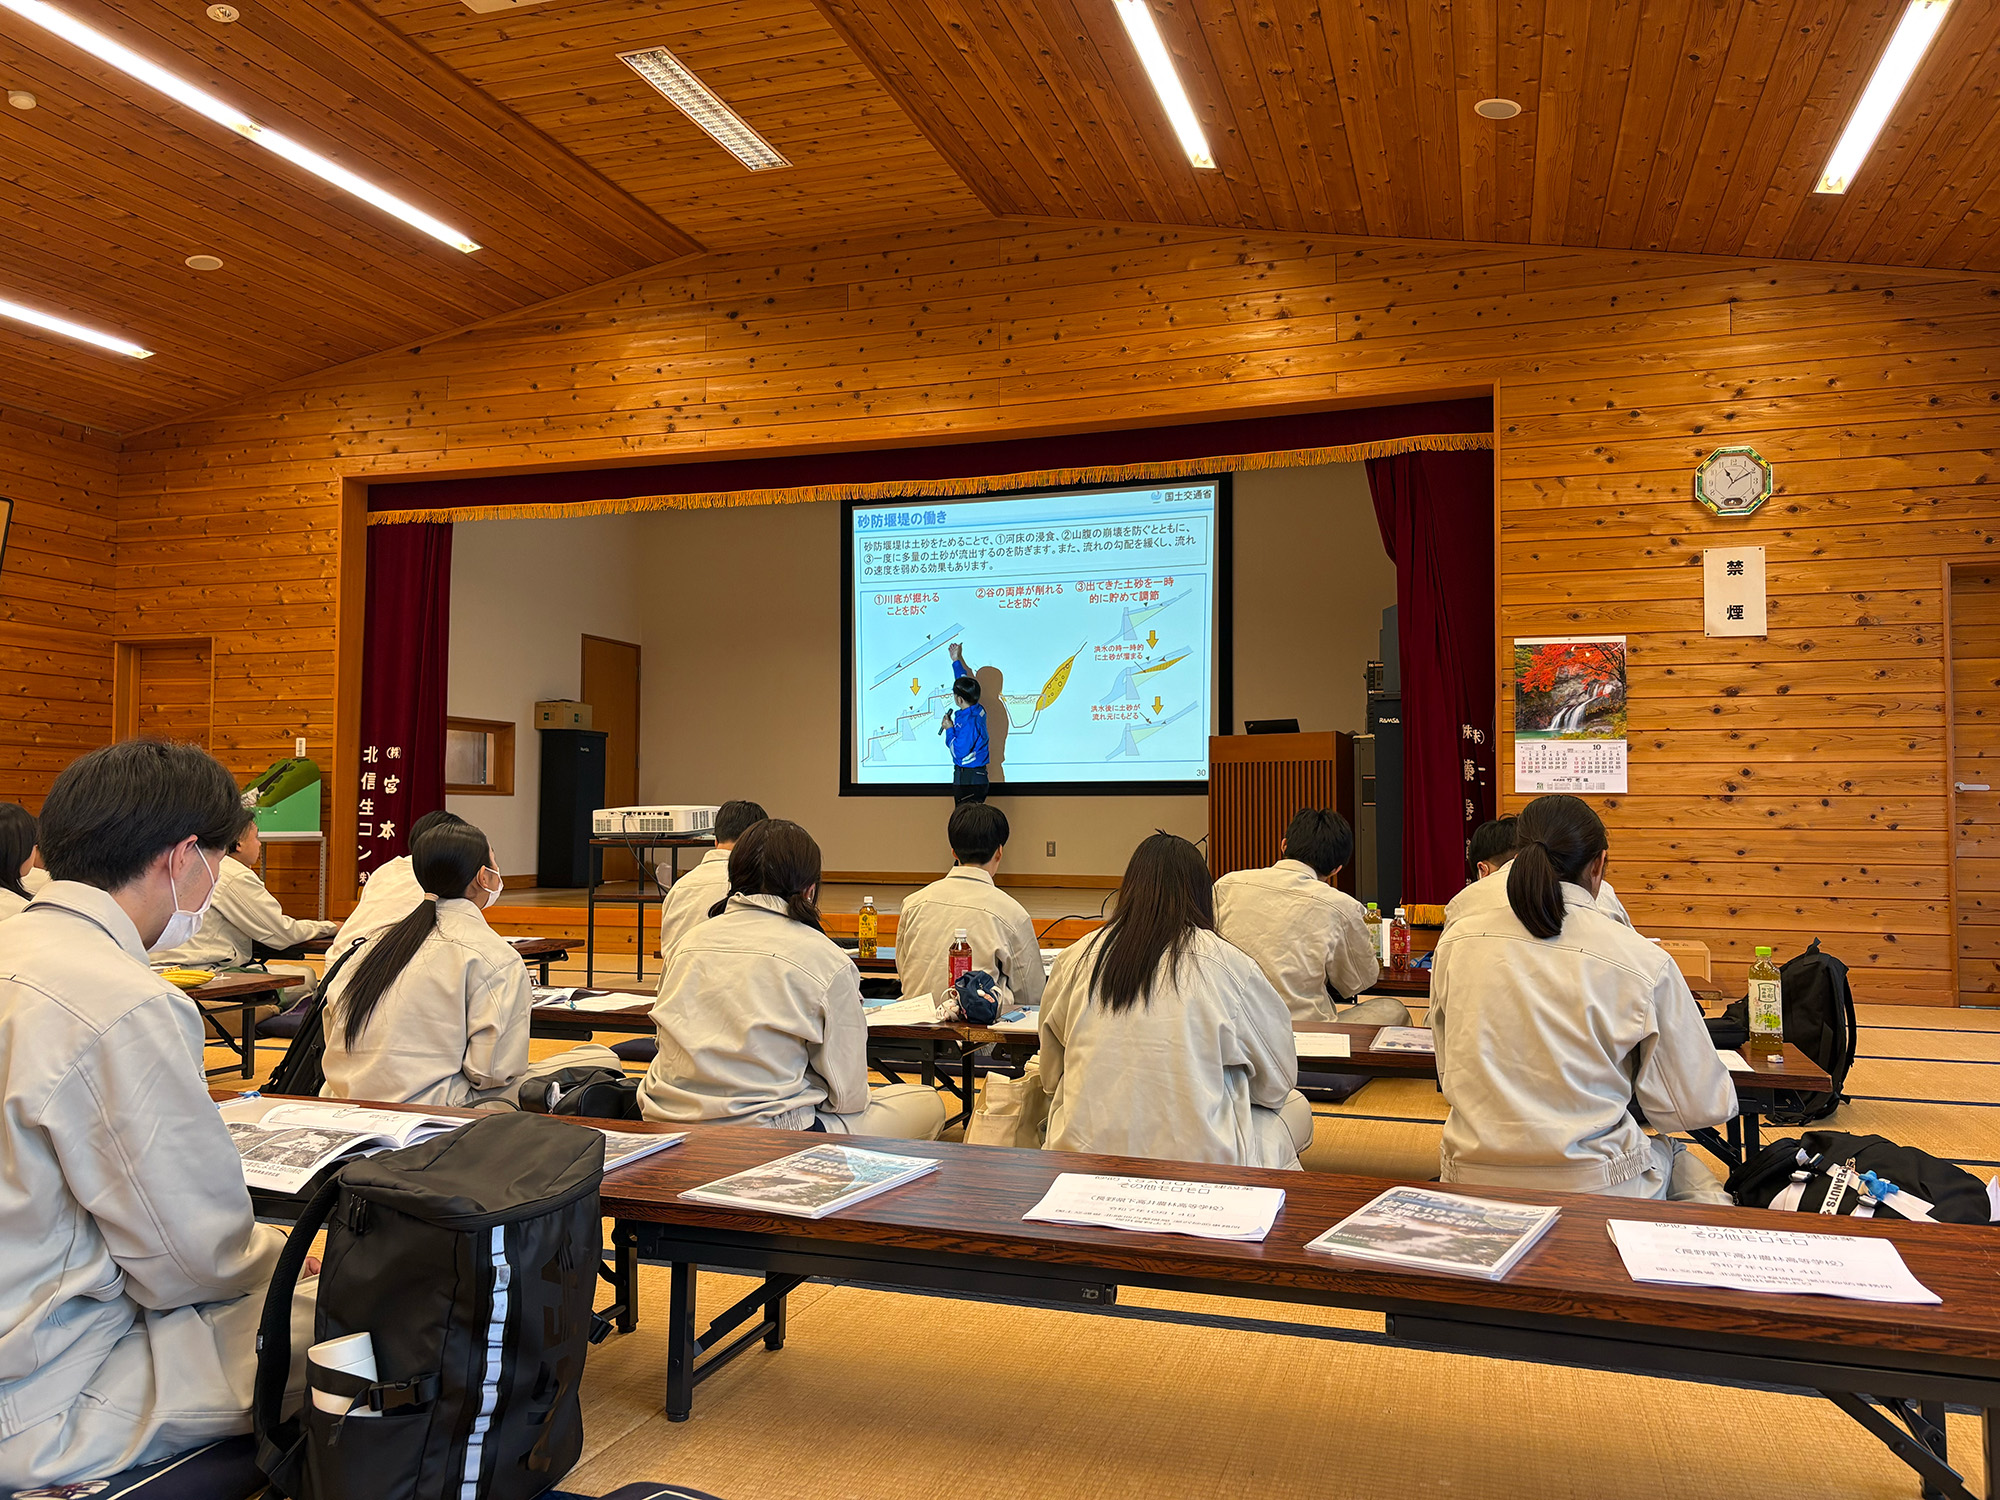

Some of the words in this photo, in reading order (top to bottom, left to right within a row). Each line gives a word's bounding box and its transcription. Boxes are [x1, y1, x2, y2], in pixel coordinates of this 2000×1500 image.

[1165, 489, 1212, 502] 国土交通省
[857, 510, 947, 529] 砂防堰堤の働き
[864, 560, 994, 576] の速度を弱める効果もあります。
[975, 583, 1064, 599] ②谷の両岸が削れる
[1075, 576, 1174, 592] ③出てきた土砂を一時
[1726, 560, 1744, 621] 禁煙
[874, 592, 940, 605] ①川底が掘れる
[998, 597, 1041, 609] ことを防ぐ
[1089, 591, 1159, 604] 的に貯めて調節
[886, 605, 927, 616] ことを防ぐ
[1196, 769, 1207, 777] 30
[1826, 1166, 1849, 1208] PEANUTS
[1691, 1230, 1810, 1246] その他モロモロ
